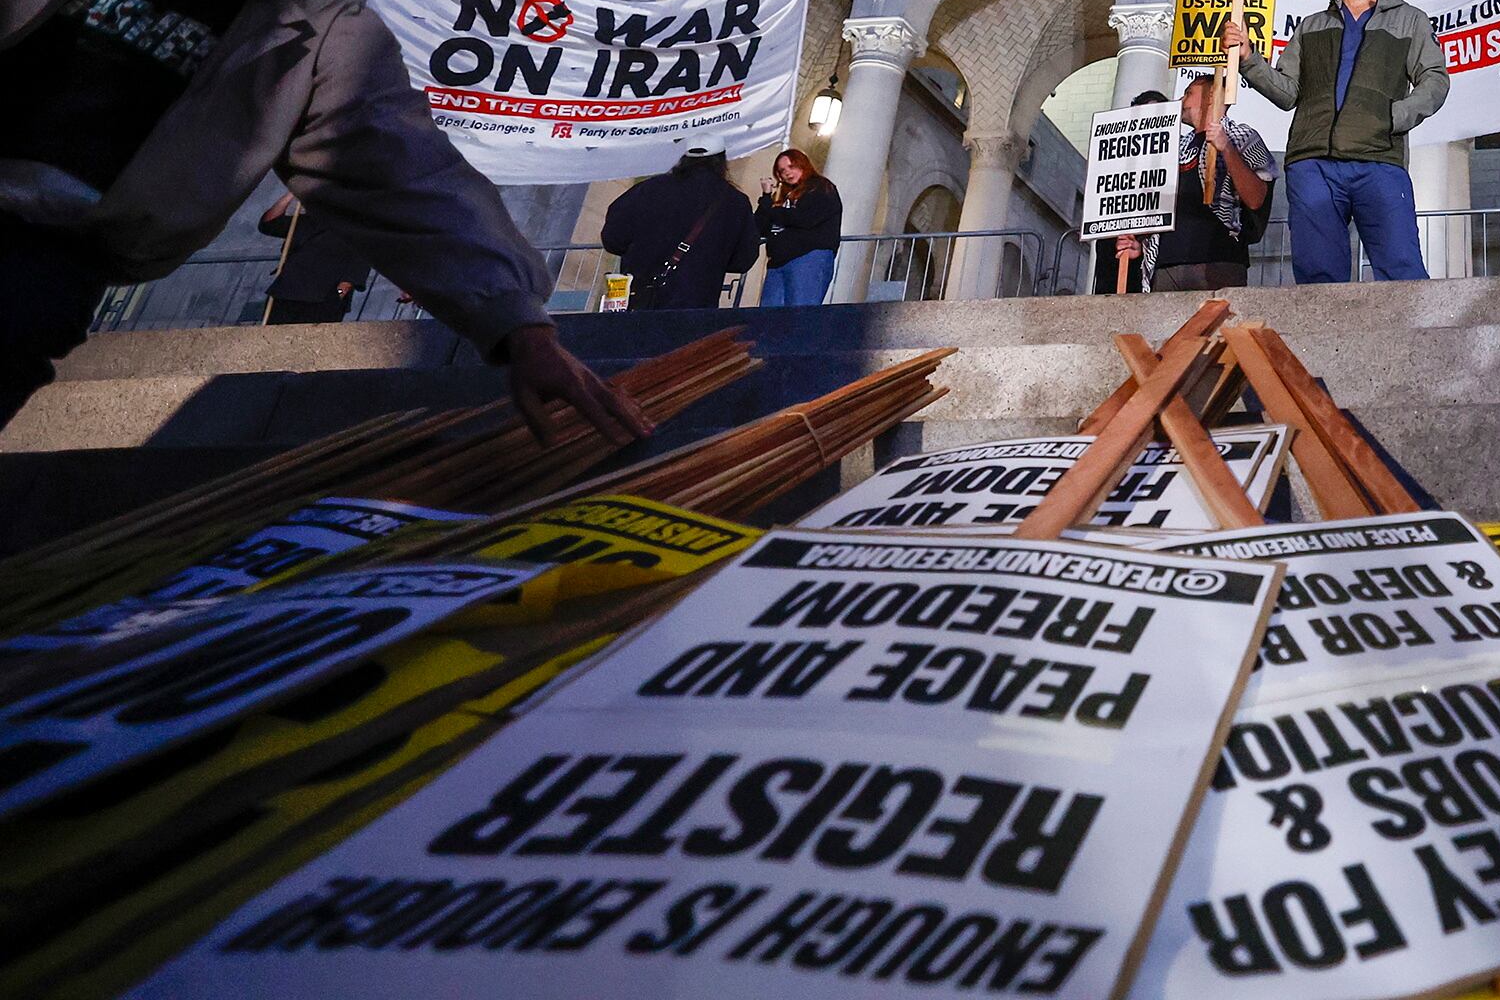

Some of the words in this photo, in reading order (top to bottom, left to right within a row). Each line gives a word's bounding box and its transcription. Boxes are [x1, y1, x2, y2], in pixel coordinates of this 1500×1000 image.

[1176, 55, 1226, 63] ANSWERCOAL
[1178, 39, 1204, 53] ON
[1441, 34, 1481, 68] EW
[430, 37, 563, 95] ON
[585, 36, 762, 99] IRAN
[428, 92, 479, 107] END
[486, 98, 535, 114] THE
[540, 104, 652, 118] GENOCIDE
[657, 101, 676, 111] IN
[680, 89, 741, 108] GAZA!
[551, 123, 573, 139] PSL
[579, 127, 609, 138] Party
[611, 126, 626, 136] for
[628, 123, 678, 136] Socialism
[682, 120, 688, 128] &
[692, 110, 740, 127] Liberation
[1095, 121, 1127, 136] ENOUGH
[1128, 119, 1138, 132] IS
[1138, 114, 1177, 130] ENOUGH!
[1098, 132, 1169, 161] REGISTER
[1097, 172, 1136, 193] PEACE
[1139, 169, 1166, 188] AND
[1099, 192, 1160, 216] FREEDOM
[1089, 215, 1163, 233] @PEACEANDFREEDOMCA
[888, 465, 1178, 502] FREDOM
[1212, 533, 1322, 559] FREEDOM
[1322, 529, 1363, 550] AND
[1366, 524, 1433, 548] PEACE
[798, 541, 1227, 596] @PEACEANDFREEDOMCA
[1447, 561, 1493, 591] &
[1275, 563, 1452, 612] DEPOR
[749, 579, 1155, 653] FREEDOM
[1308, 613, 1435, 657] FOR
[636, 639, 864, 698] AND
[846, 642, 1151, 730] PEACE
[424, 754, 1103, 895] REGISTER
[1256, 784, 1331, 854] &
[625, 883, 768, 959] IS
[1187, 863, 1407, 977] FOR
[725, 889, 1106, 996] ENOUGH
